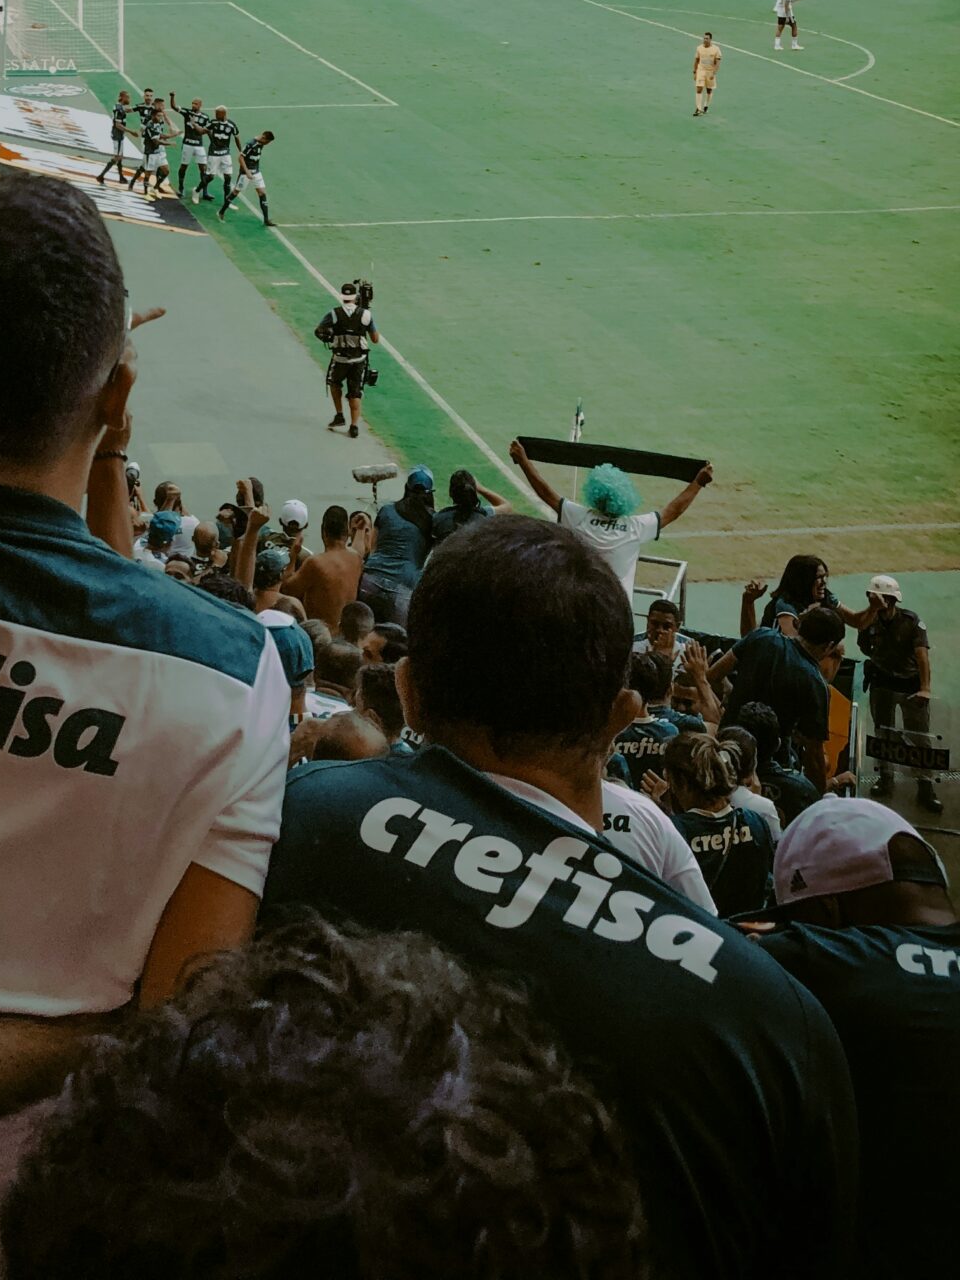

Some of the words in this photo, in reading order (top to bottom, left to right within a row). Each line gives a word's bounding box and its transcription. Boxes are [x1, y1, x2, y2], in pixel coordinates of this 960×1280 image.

[590, 517, 627, 533] crefisa
[870, 737, 947, 769] CHOQUE
[690, 824, 753, 856] crefsa
[360, 797, 724, 984] crefisa
